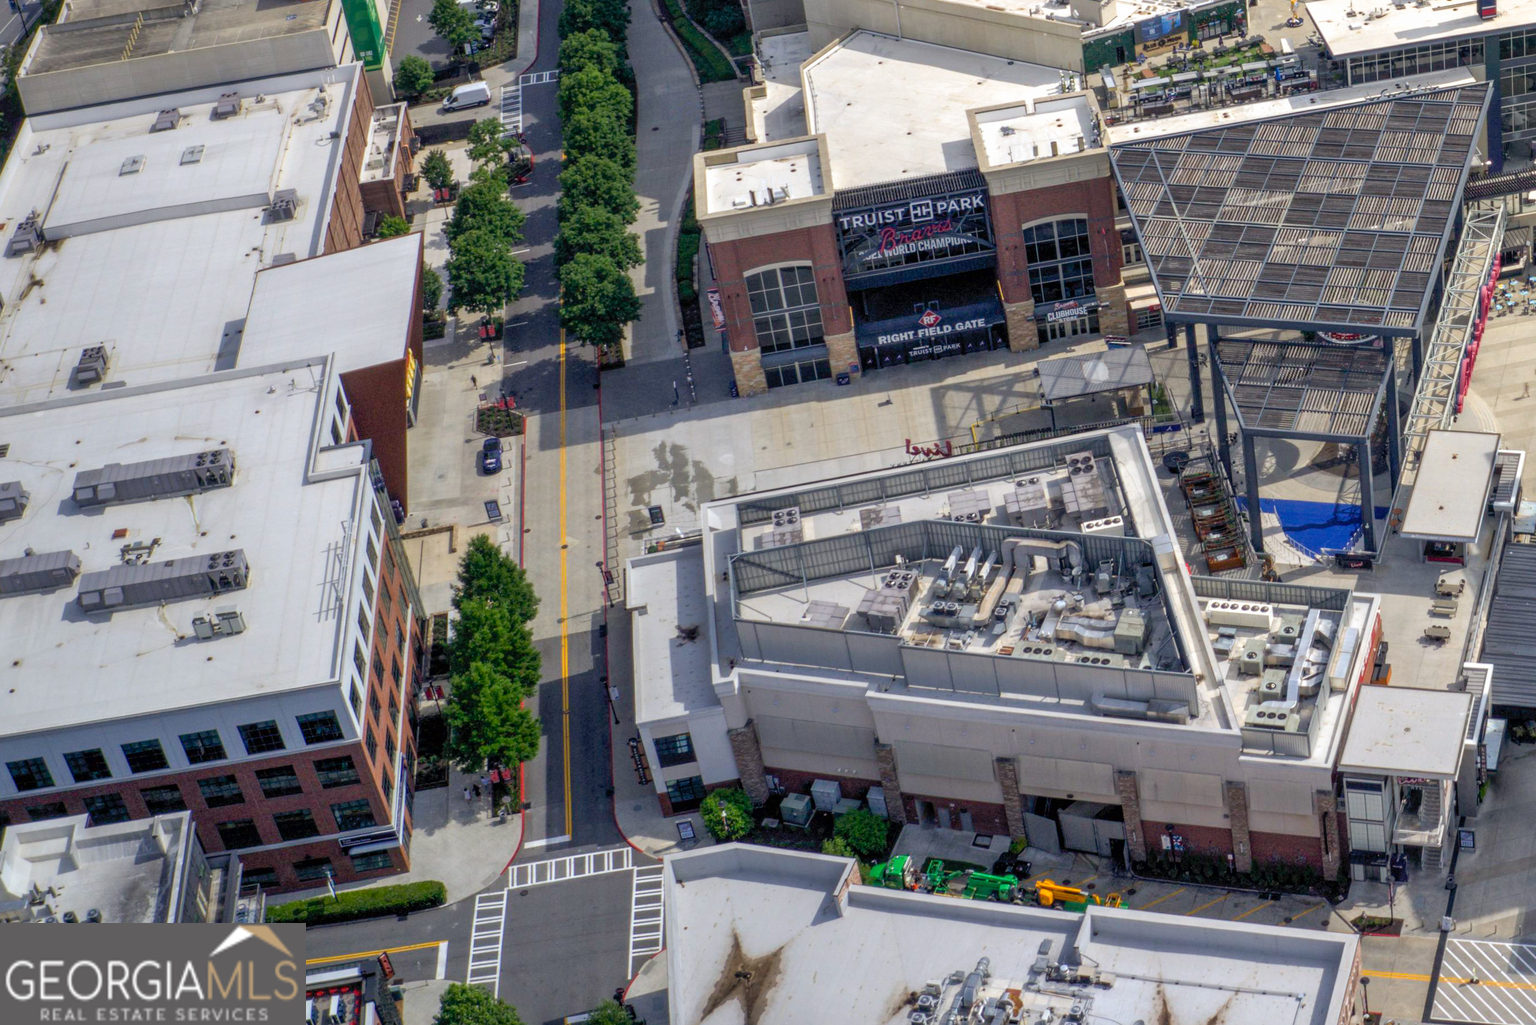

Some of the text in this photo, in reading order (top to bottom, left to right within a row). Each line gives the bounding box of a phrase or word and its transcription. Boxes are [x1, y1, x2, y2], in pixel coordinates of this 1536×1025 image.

[840, 195, 985, 230] TRUIST PARK
[879, 219, 952, 254] Braves
[883, 242, 917, 257] WORLD
[923, 315, 937, 325] RF
[1047, 306, 1088, 322] CLUBHOUSE
[1059, 315, 1079, 323] STORE
[878, 318, 986, 345] RIGHT FIELD GATE
[909, 343, 961, 357] TRUIST PARK
